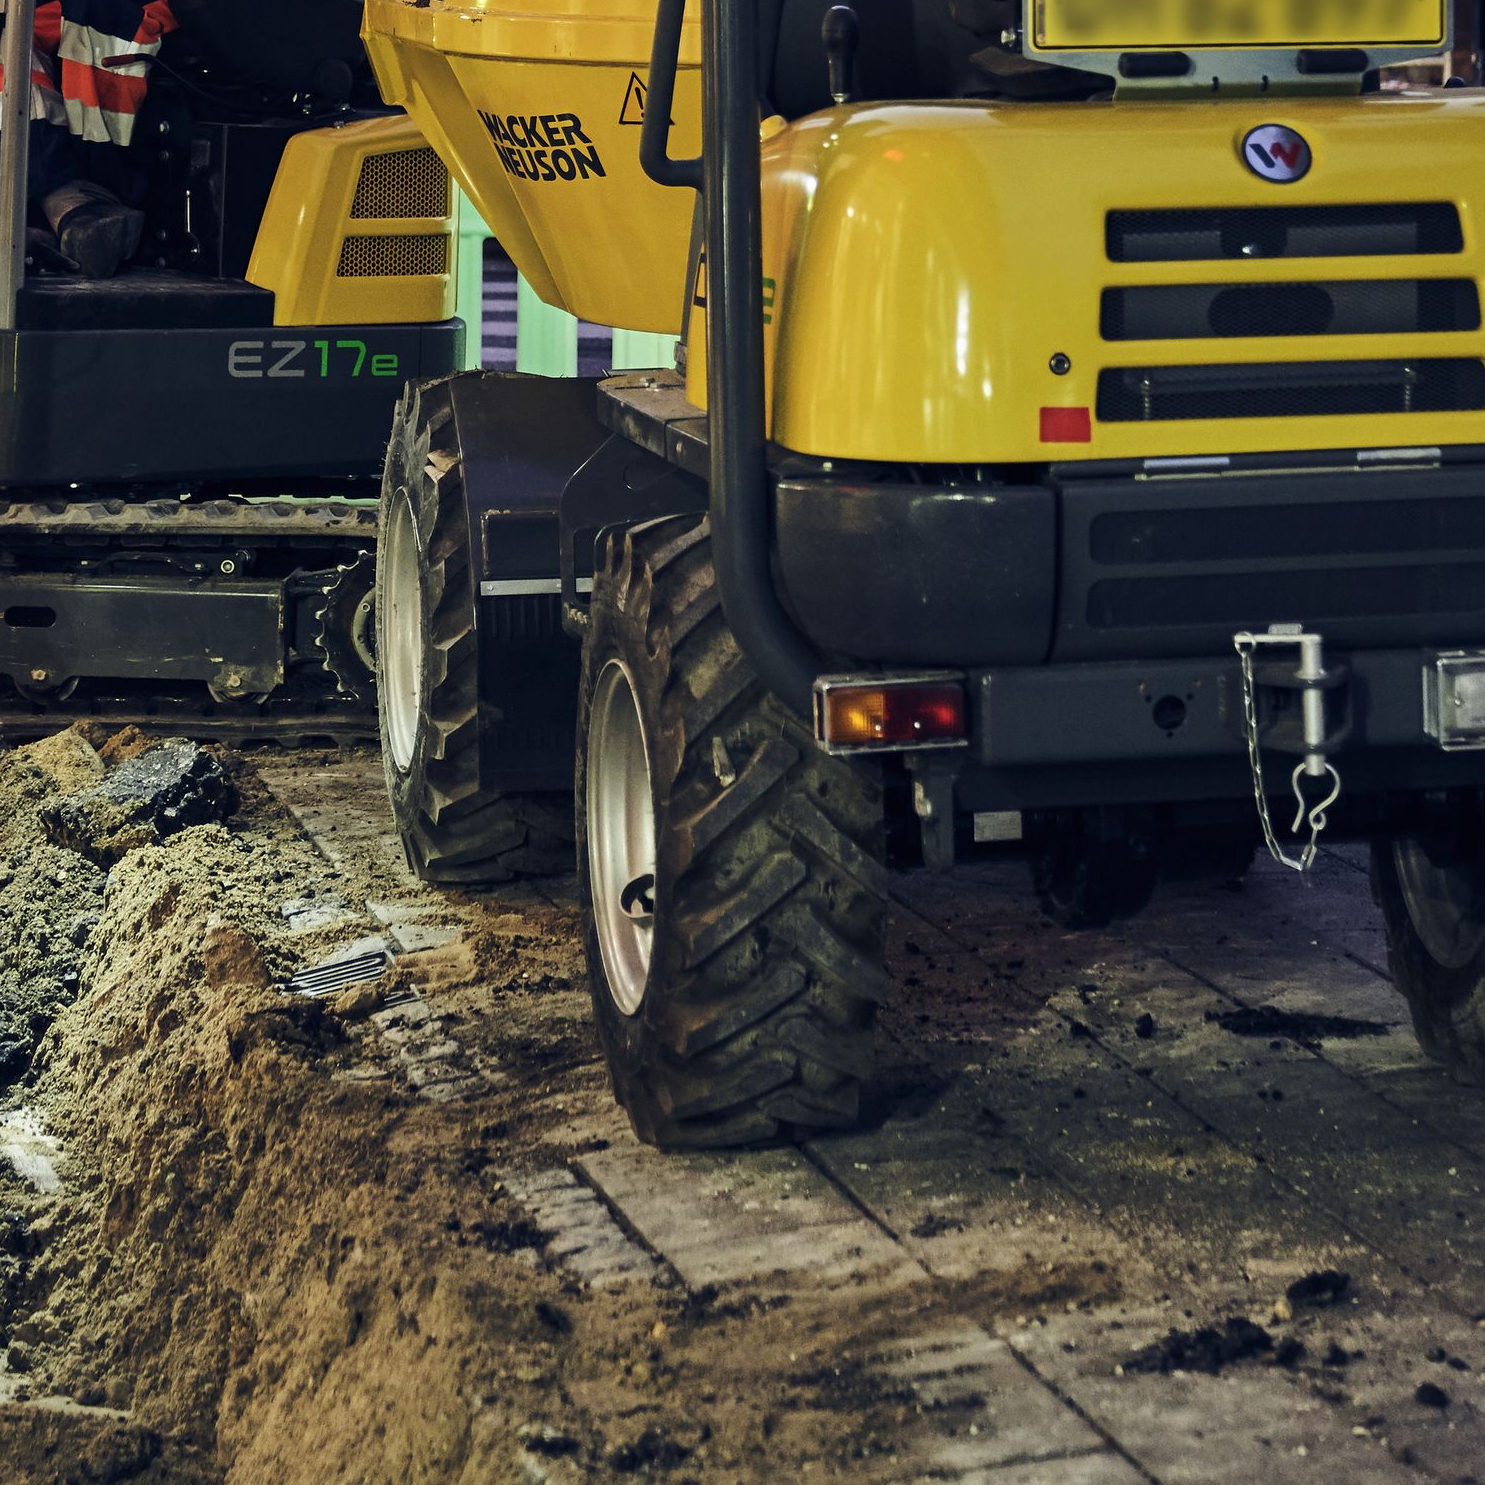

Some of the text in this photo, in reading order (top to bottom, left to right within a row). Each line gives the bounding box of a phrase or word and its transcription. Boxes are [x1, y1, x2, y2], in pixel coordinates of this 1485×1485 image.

[476, 112, 593, 148] WACKER
[493, 145, 607, 182] NEUSON
[227, 340, 399, 378] EZ17e
